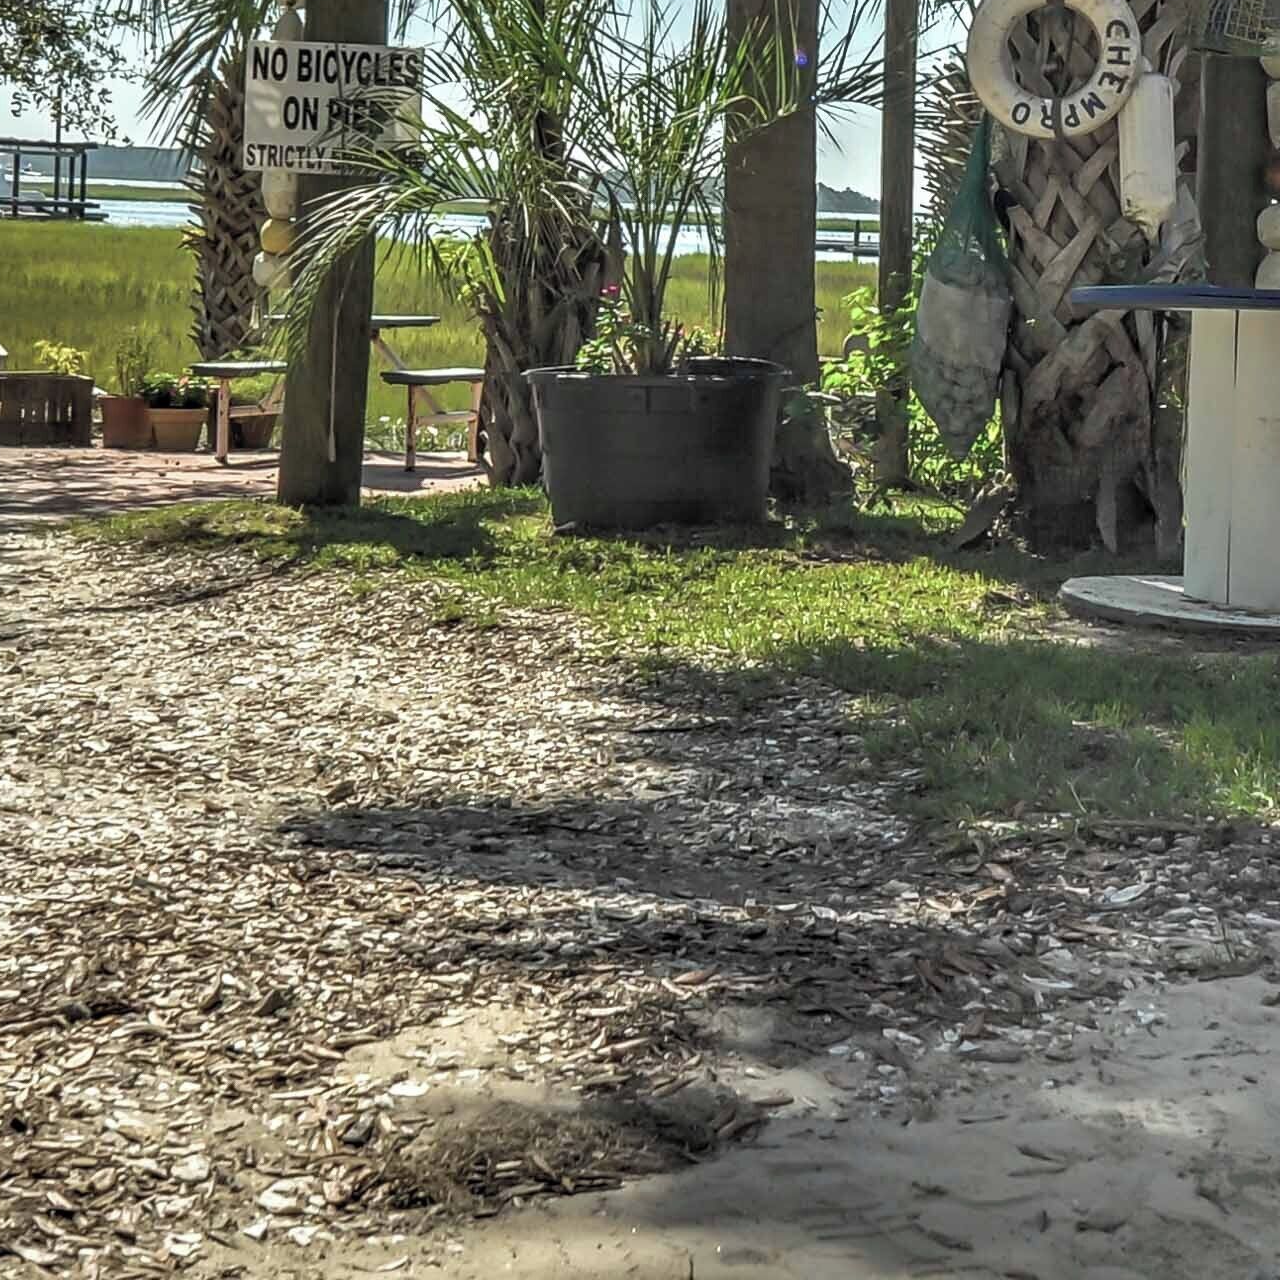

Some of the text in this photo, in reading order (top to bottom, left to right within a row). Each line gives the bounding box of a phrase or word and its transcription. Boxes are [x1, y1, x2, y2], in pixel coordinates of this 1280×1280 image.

[252, 46, 419, 87] NO BICYCLES
[284, 96, 319, 130] ON
[246, 143, 326, 170] STRICTLY
